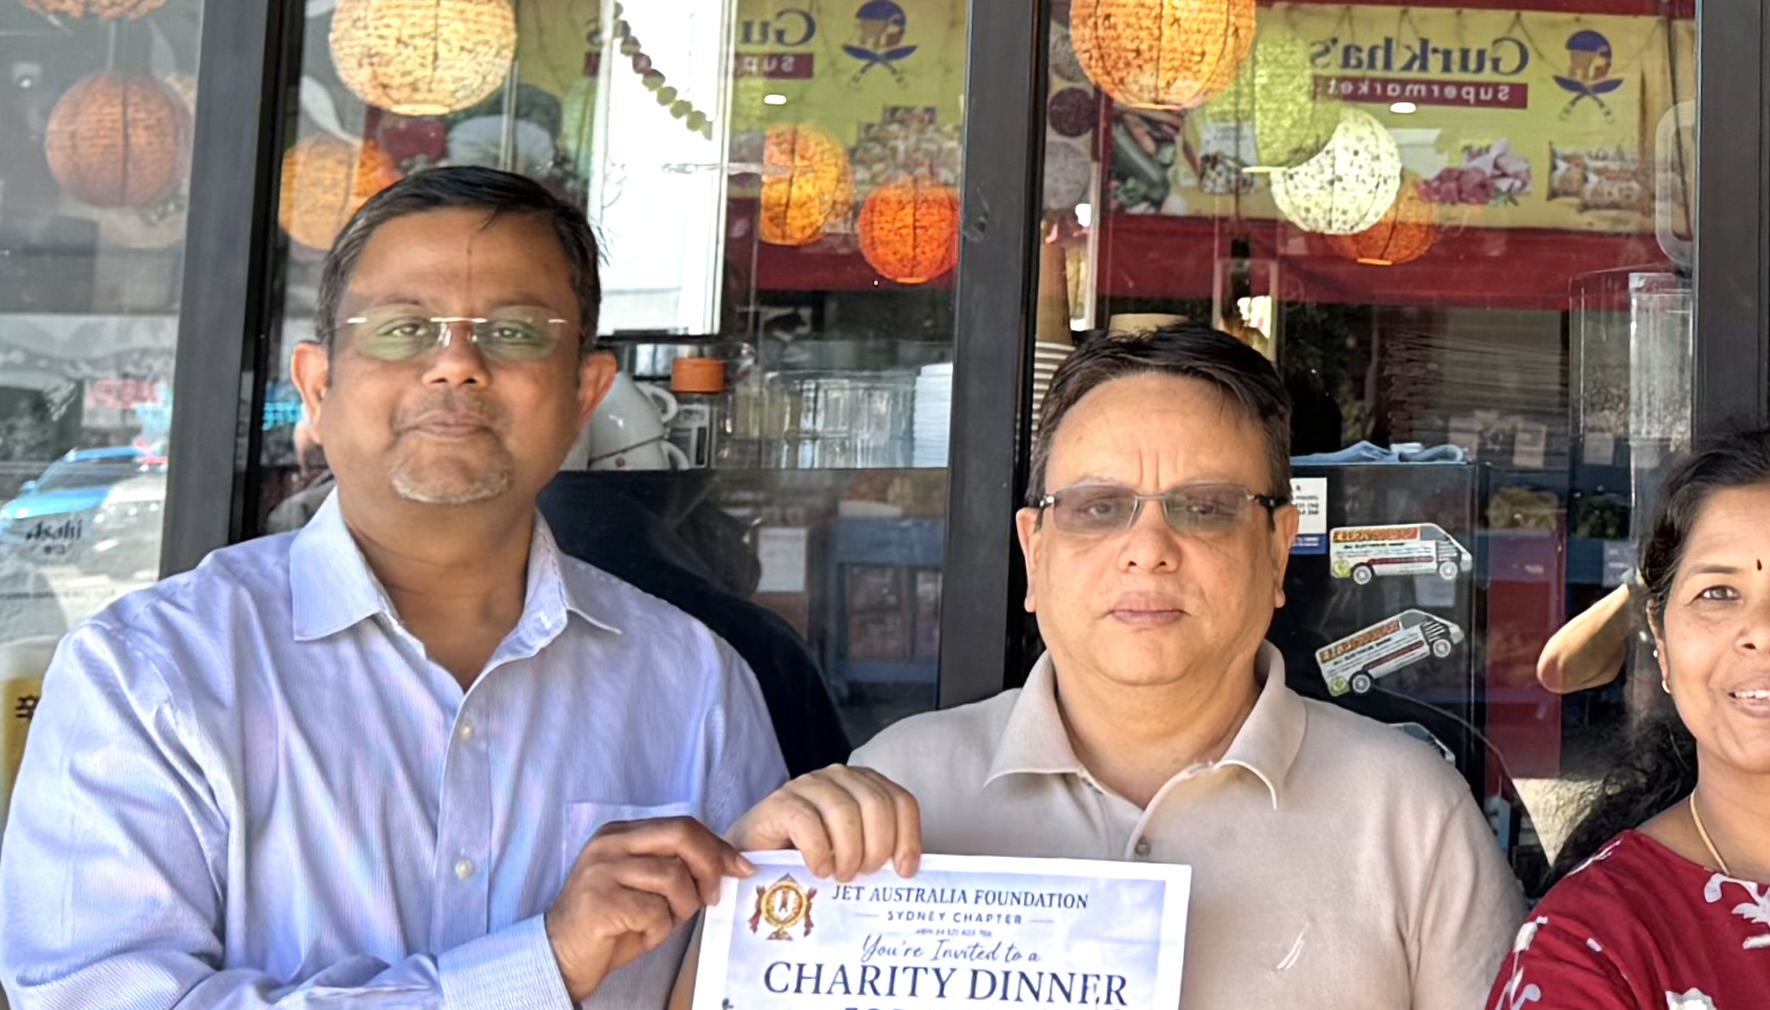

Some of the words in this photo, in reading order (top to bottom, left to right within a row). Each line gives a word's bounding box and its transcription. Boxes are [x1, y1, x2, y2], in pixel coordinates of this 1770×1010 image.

[832, 885, 866, 901] JET
[869, 887, 968, 905] AUSTRALIA
[974, 889, 1088, 909] FOUNDATION
[888, 911, 946, 922] SYDNEY
[953, 912, 1023, 924] CHAPTER
[861, 934, 924, 963] You're
[930, 939, 1002, 962] Invited
[1004, 941, 1023, 963] to
[1028, 951, 1041, 962] a
[764, 961, 957, 999] CHARITY
[967, 968, 1128, 1007] DINNER
